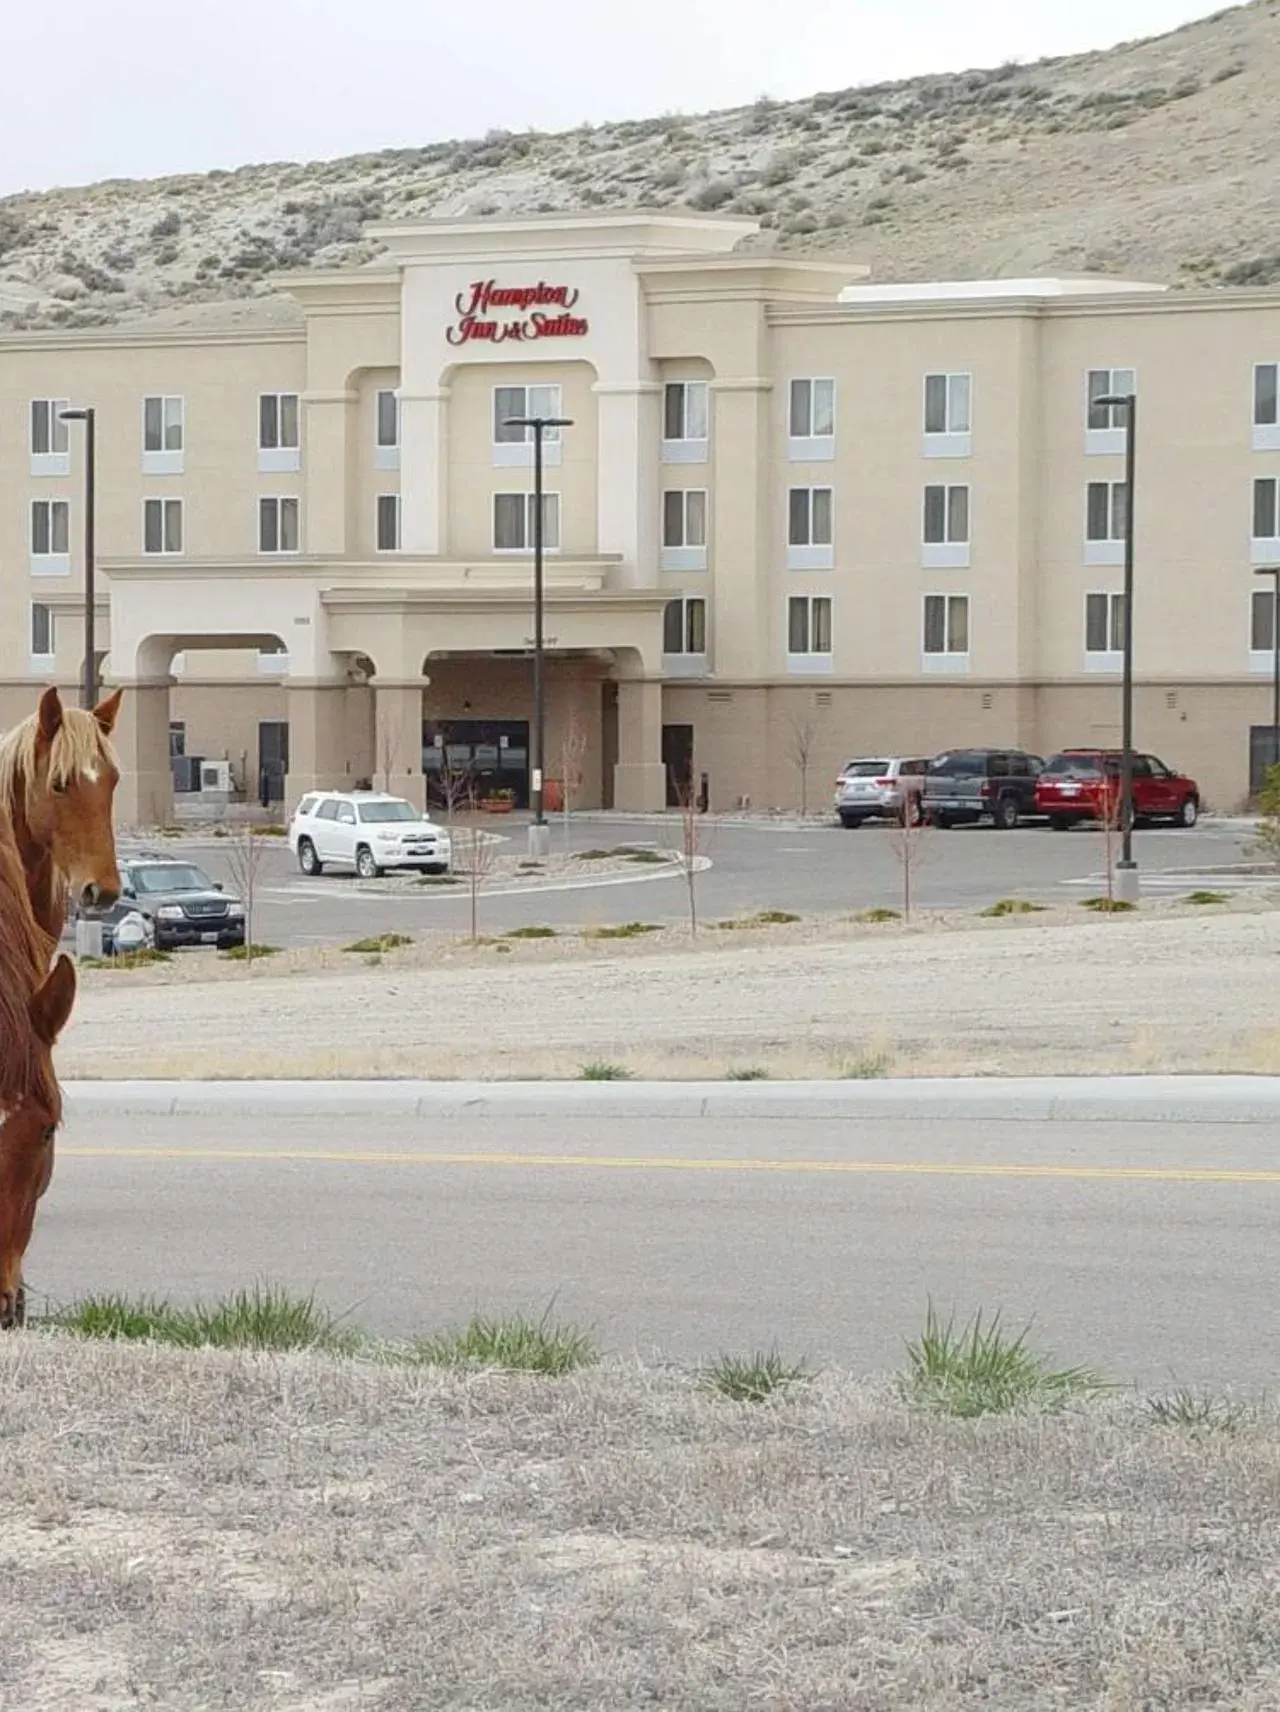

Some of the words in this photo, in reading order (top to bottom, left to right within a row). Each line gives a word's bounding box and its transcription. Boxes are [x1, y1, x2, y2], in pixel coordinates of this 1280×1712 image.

[455, 279, 579, 316] Hampton
[446, 315, 508, 346] Inn
[507, 321, 524, 341] &
[522, 312, 589, 340] Suites
